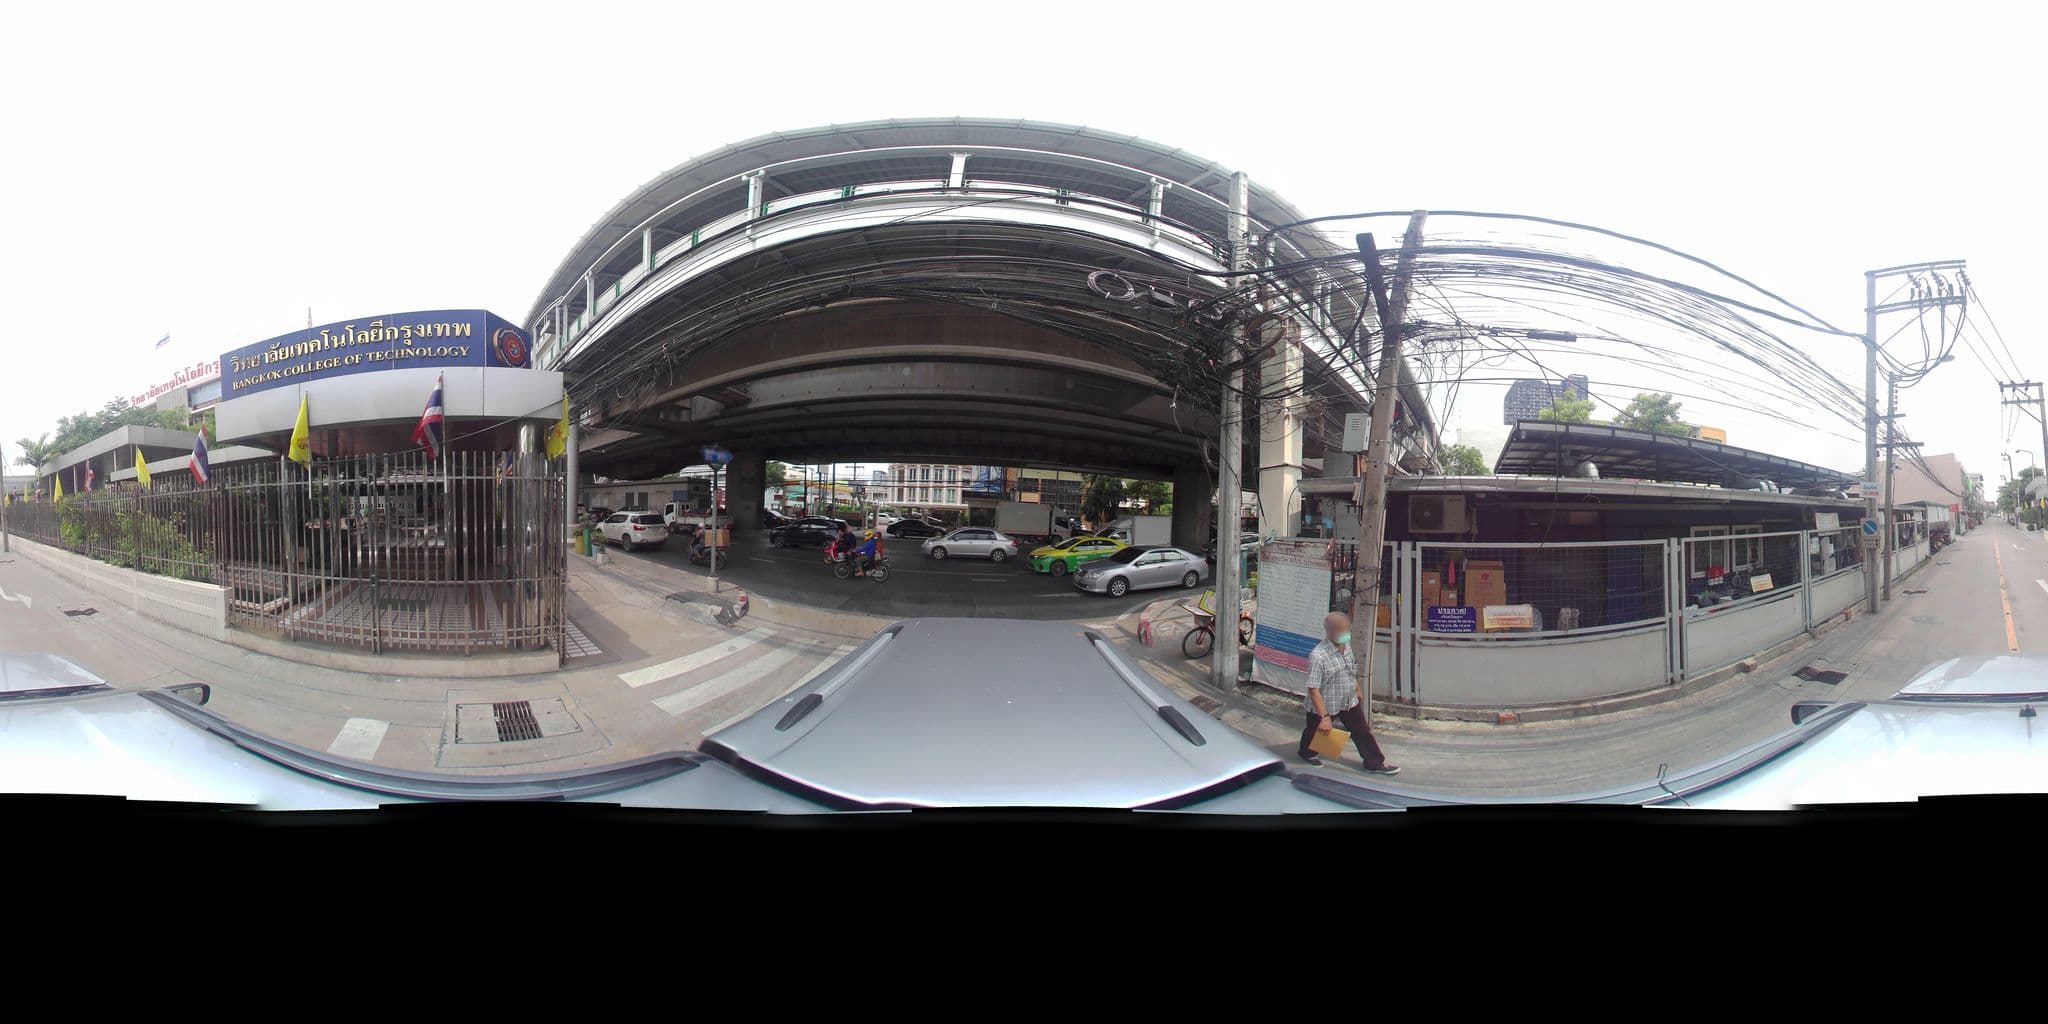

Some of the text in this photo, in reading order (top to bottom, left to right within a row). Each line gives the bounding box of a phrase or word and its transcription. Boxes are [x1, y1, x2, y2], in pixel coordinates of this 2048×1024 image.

[232, 346, 470, 390] BANGKOK COLLEGE OF TECHNOLOGY
